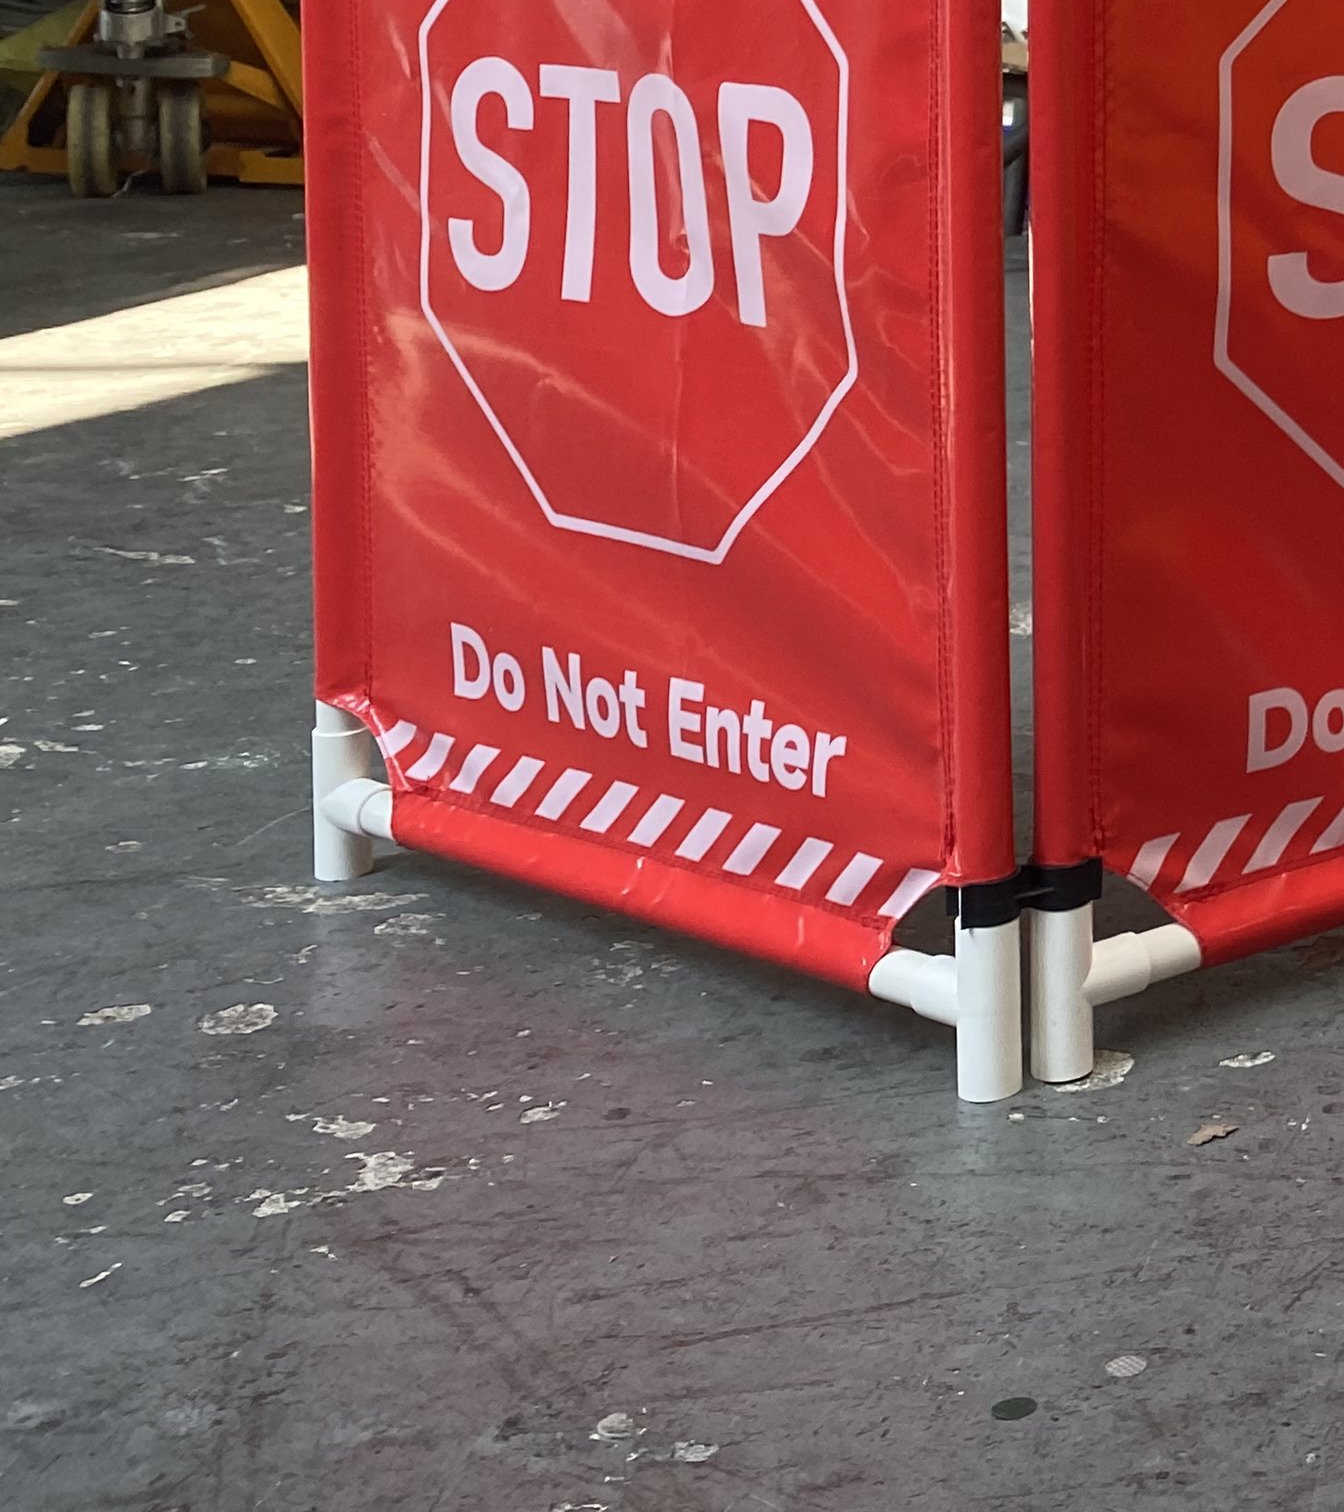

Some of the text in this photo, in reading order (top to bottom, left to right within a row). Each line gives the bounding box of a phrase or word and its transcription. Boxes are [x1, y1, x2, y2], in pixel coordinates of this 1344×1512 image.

[448, 56, 814, 327] STOP
[450, 621, 847, 798] Do Not Enter
